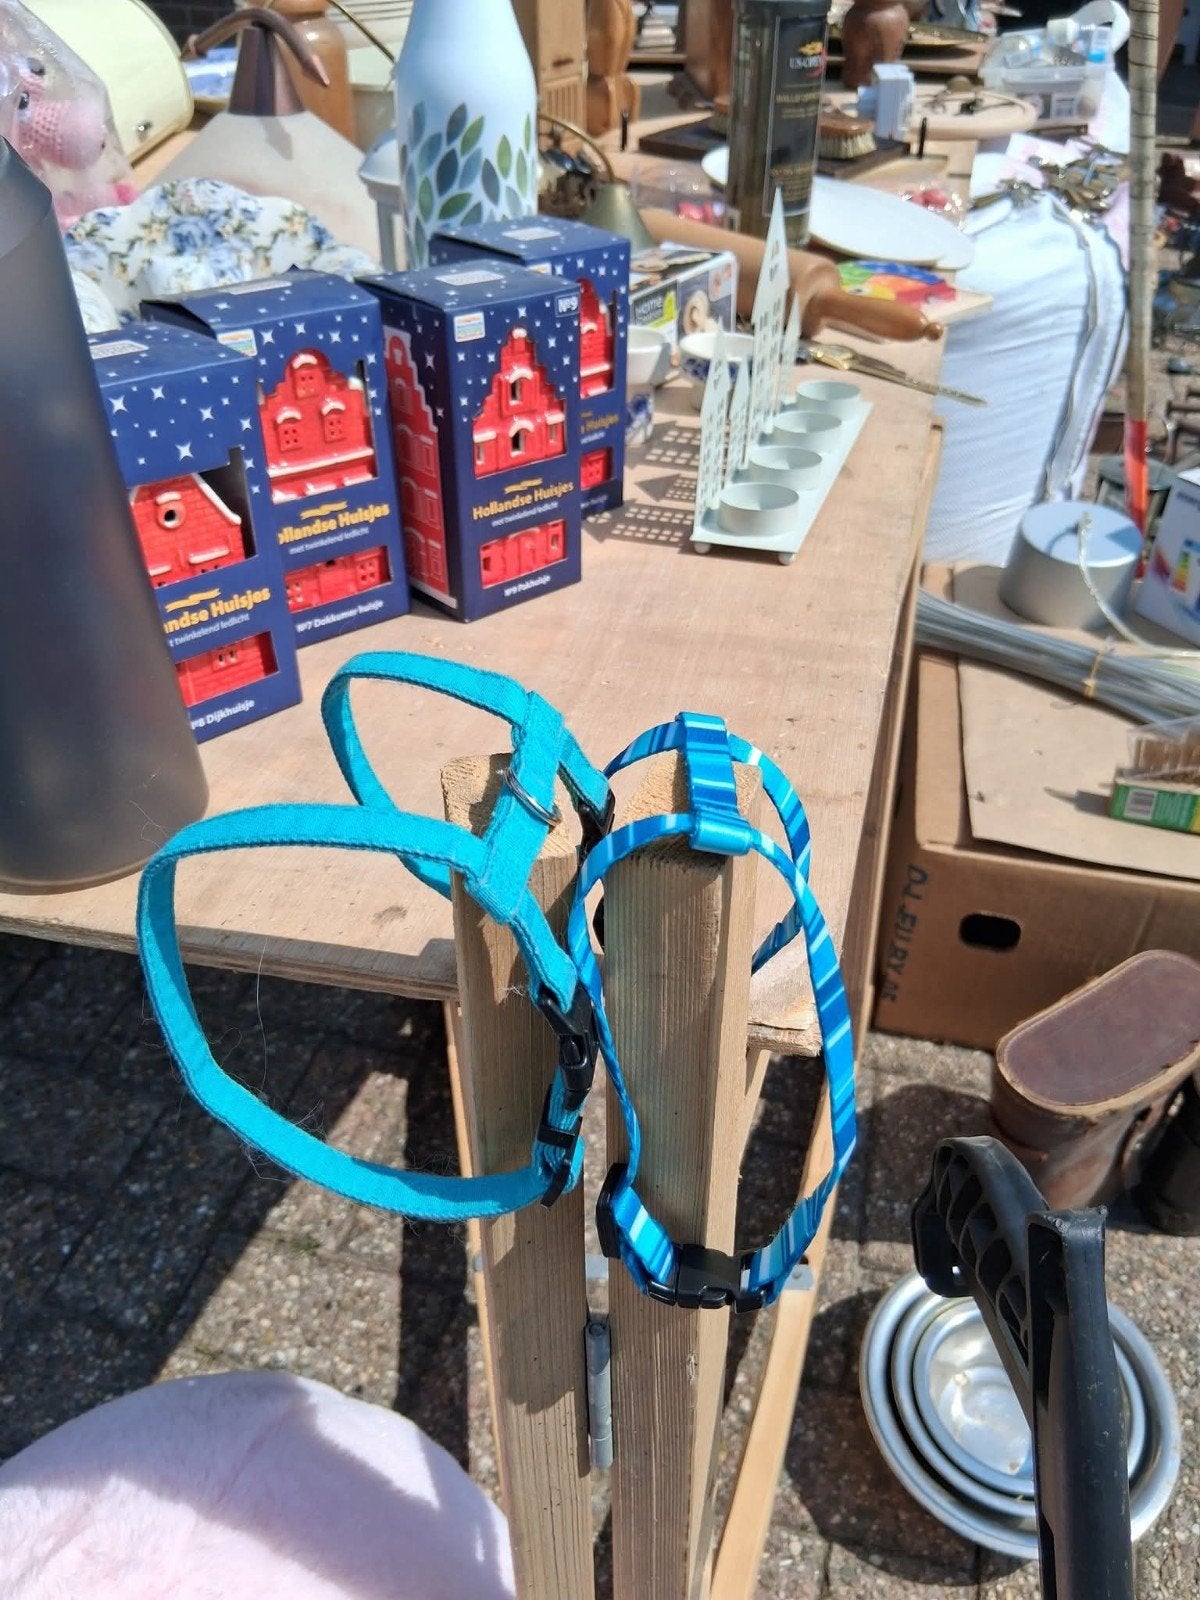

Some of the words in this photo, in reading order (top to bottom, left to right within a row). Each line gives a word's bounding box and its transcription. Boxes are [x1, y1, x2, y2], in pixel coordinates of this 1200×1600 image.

[337, 503, 390, 527] Huisjes
[472, 493, 533, 520] Hollandse
[533, 481, 574, 502] Huisjes
[288, 543, 305, 555] met
[305, 533, 345, 551] twinkelend
[344, 526, 370, 541] ledlicht
[517, 574, 551, 592] Pakhuisje
[209, 587, 272, 618] Huisjes
[313, 606, 359, 629] Dokkumer
[358, 599, 385, 615] huisje
[174, 619, 221, 646] twinkelend
[220, 612, 251, 630] ledlicht
[206, 699, 256, 725] Dijkhuisje
